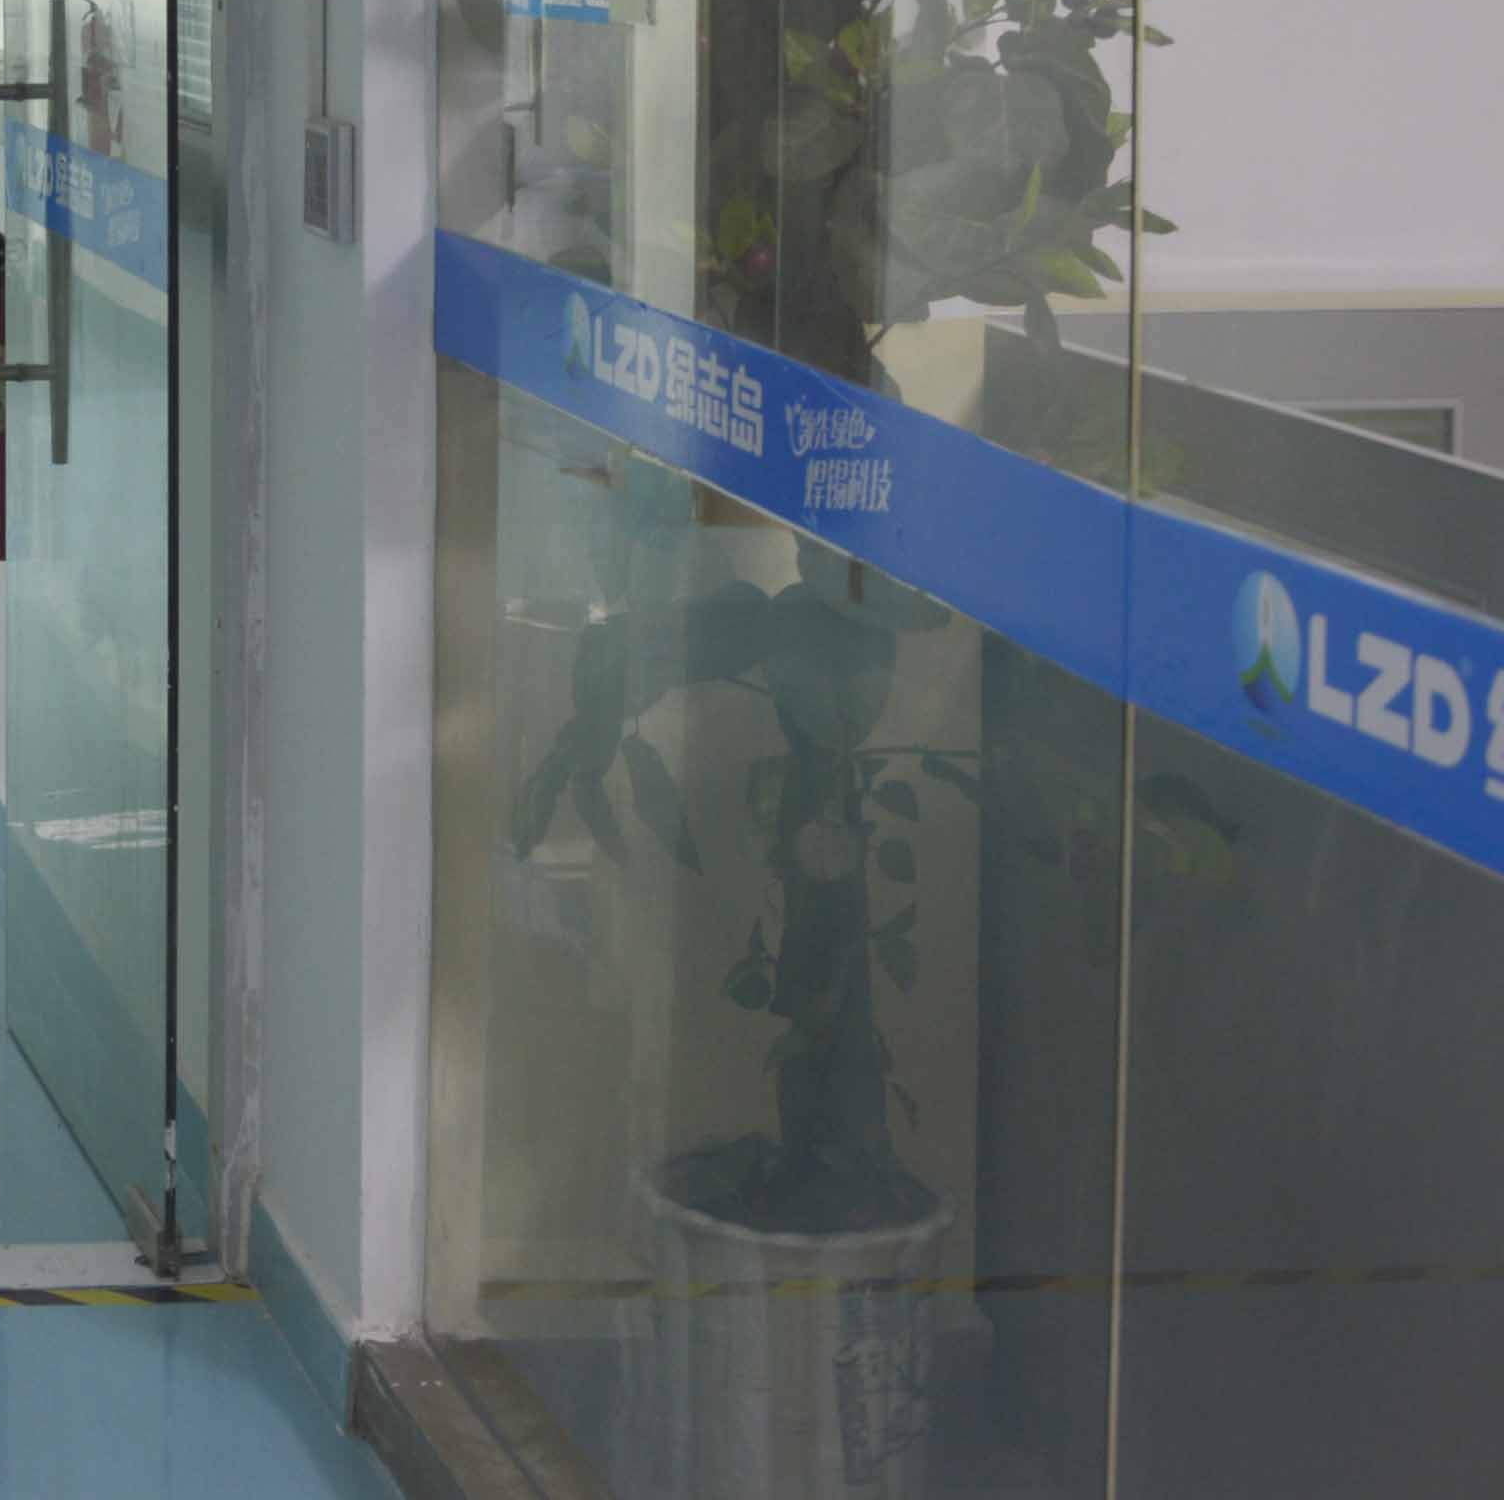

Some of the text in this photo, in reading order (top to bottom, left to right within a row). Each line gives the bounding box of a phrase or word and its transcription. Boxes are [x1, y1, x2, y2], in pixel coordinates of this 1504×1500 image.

[594, 315, 764, 458] LZD 绿志岛
[1307, 612, 1472, 768] LZD
